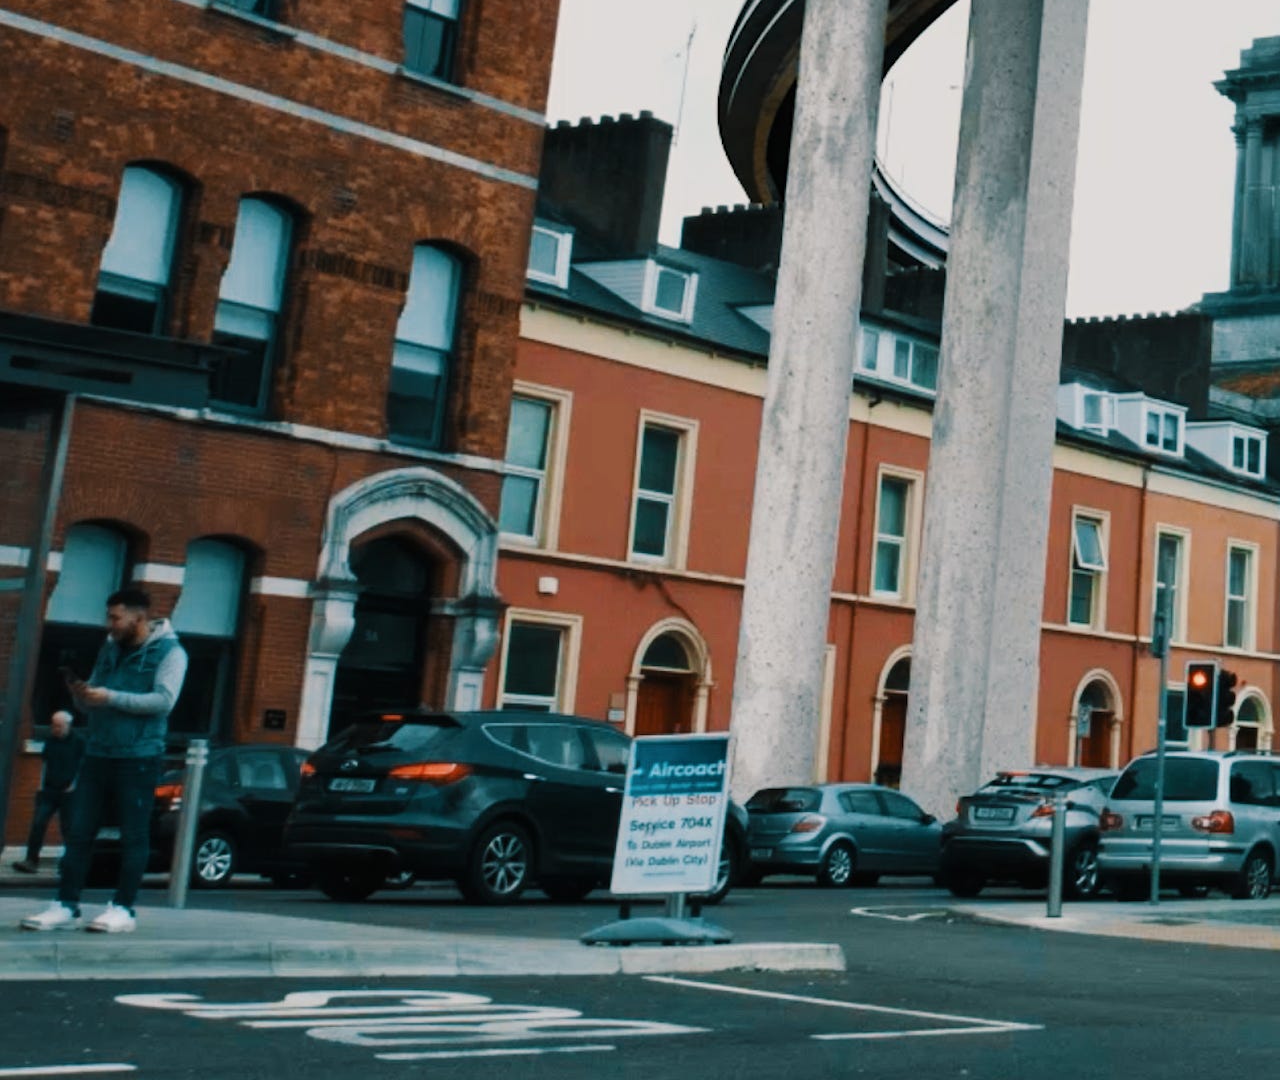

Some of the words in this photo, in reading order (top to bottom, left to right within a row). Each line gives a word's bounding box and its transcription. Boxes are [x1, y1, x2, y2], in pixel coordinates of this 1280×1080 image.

[663, 794, 680, 806] Up
[687, 793, 716, 805] Stop
[681, 817, 713, 828] 704X
